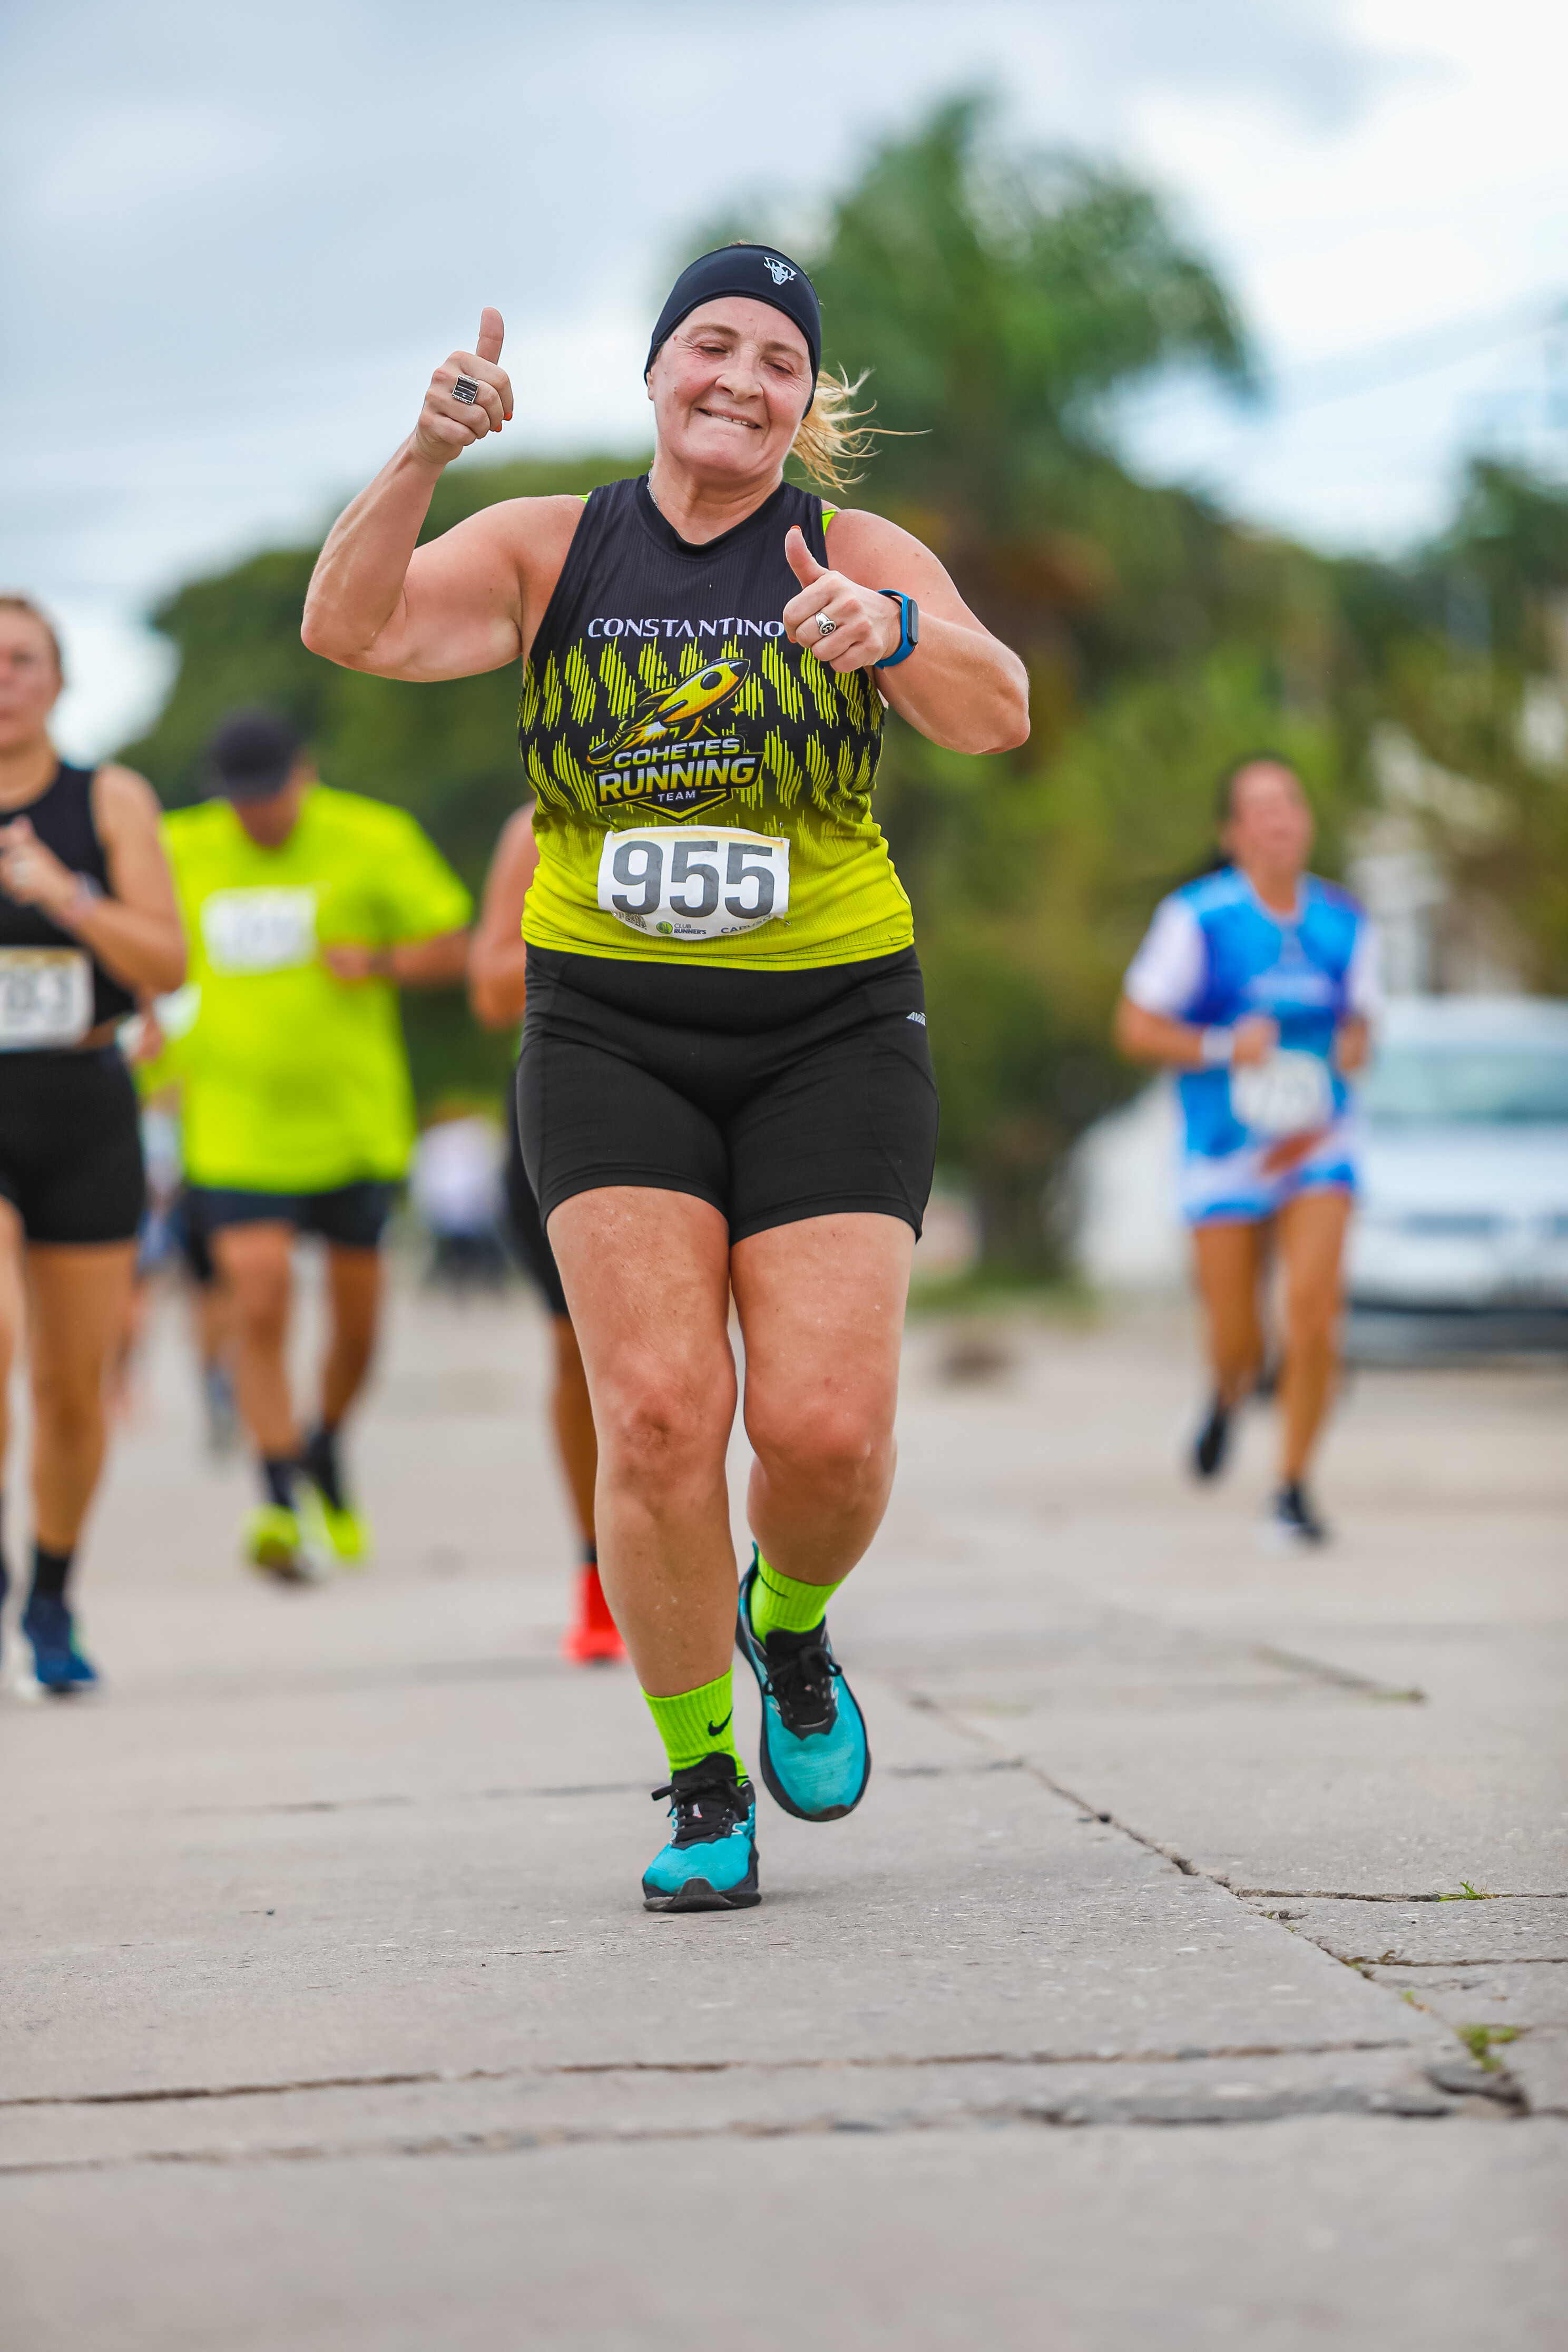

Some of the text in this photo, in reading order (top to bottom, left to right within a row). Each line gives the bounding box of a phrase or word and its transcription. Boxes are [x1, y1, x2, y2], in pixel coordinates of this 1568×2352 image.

[587, 617, 785, 638] CONSTANTINO
[614, 738, 740, 769] COHETES
[599, 757, 756, 802] RUNNING
[658, 790, 696, 802] TEAM
[612, 840, 775, 919] 955
